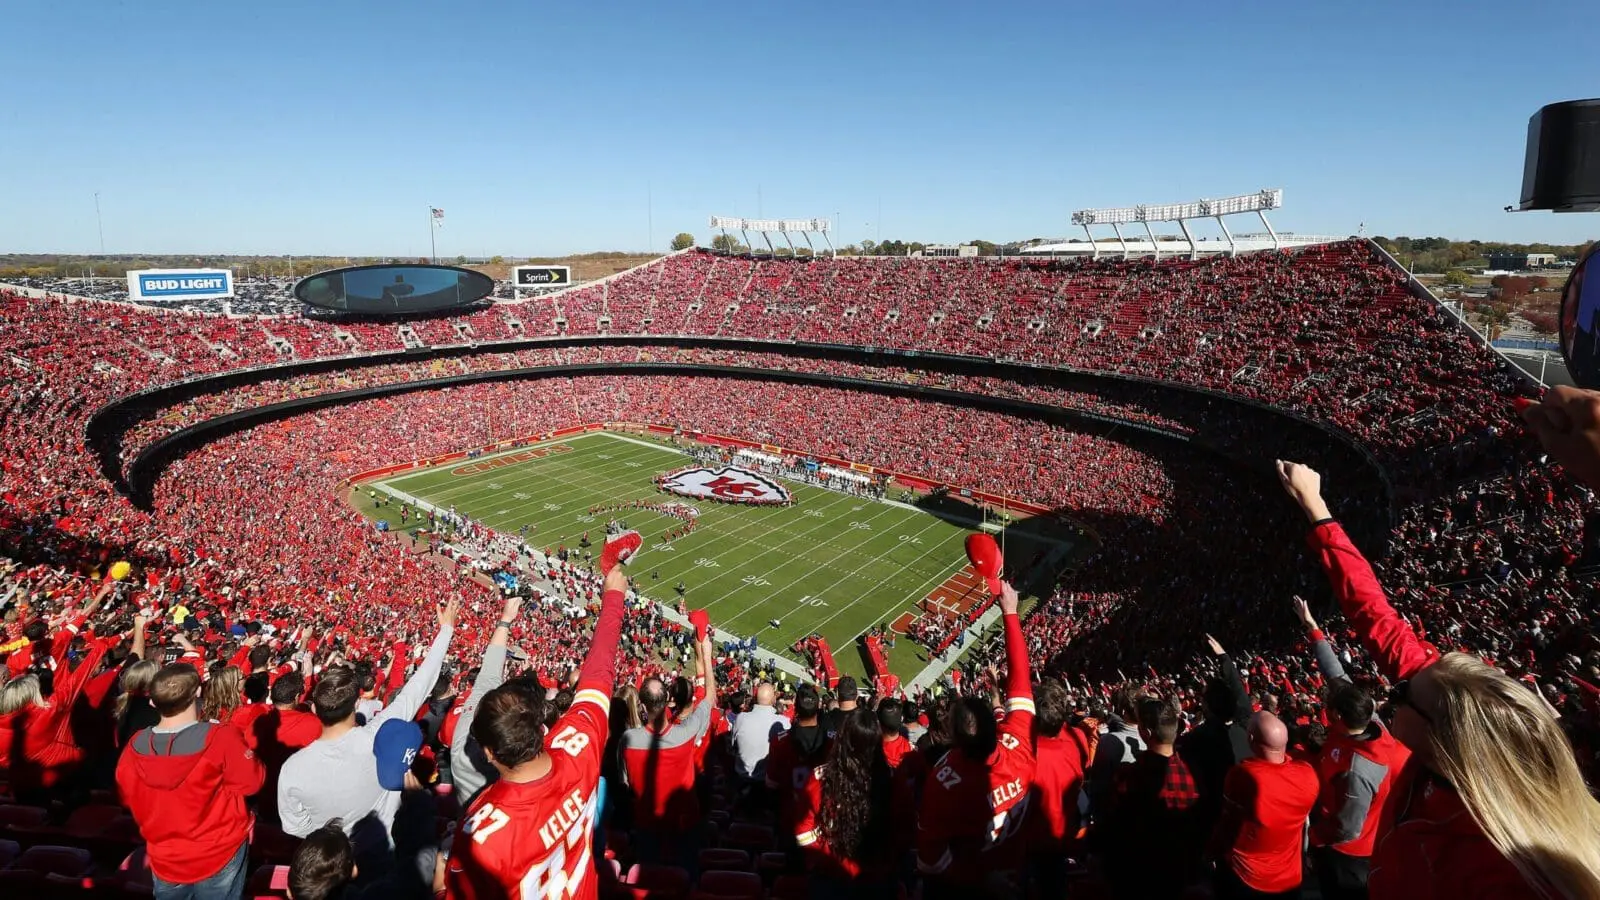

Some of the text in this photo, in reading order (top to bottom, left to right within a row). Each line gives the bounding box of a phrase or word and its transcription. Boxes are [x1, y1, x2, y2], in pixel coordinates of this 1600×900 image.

[145, 278, 223, 291] BUD LIGHT
[525, 273, 549, 283] Sprint
[451, 444, 574, 476] CHIEFS
[741, 575, 767, 586] 20
[800, 595, 823, 607] 10
[402, 748, 417, 766] KC
[936, 764, 962, 790] 87
[463, 803, 510, 844] 87
[538, 788, 587, 850] KELCE
